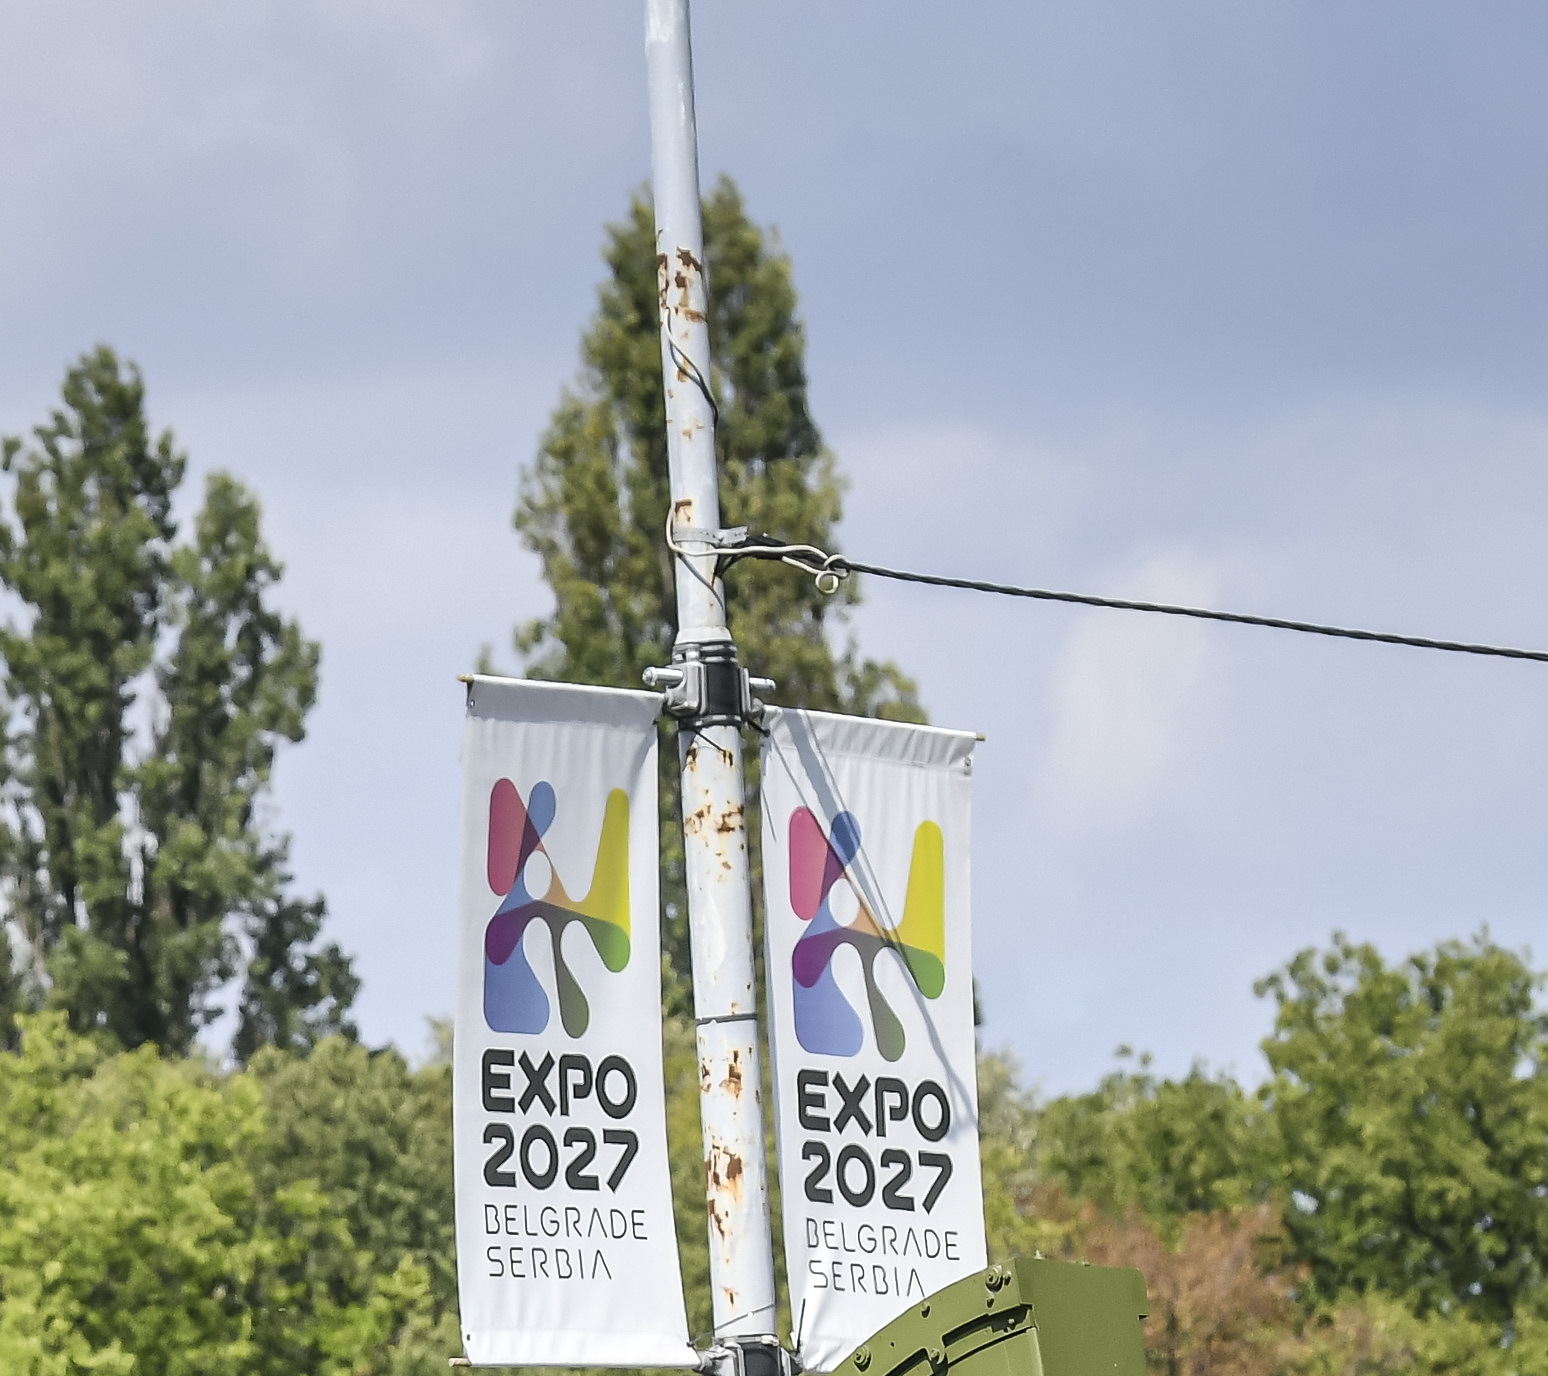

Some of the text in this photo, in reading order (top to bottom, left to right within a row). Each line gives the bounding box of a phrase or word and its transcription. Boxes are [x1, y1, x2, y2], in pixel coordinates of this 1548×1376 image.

[481, 1048, 637, 1120] EXPO
[796, 1069, 951, 1142] EXPO
[482, 1122, 639, 1193] 2027
[801, 1141, 953, 1214] 2027
[484, 1203, 648, 1240] BELGRADE
[805, 1217, 960, 1261] BELGRADE
[487, 1245, 612, 1281] SERBIA
[808, 1258, 924, 1298] SERBIA
